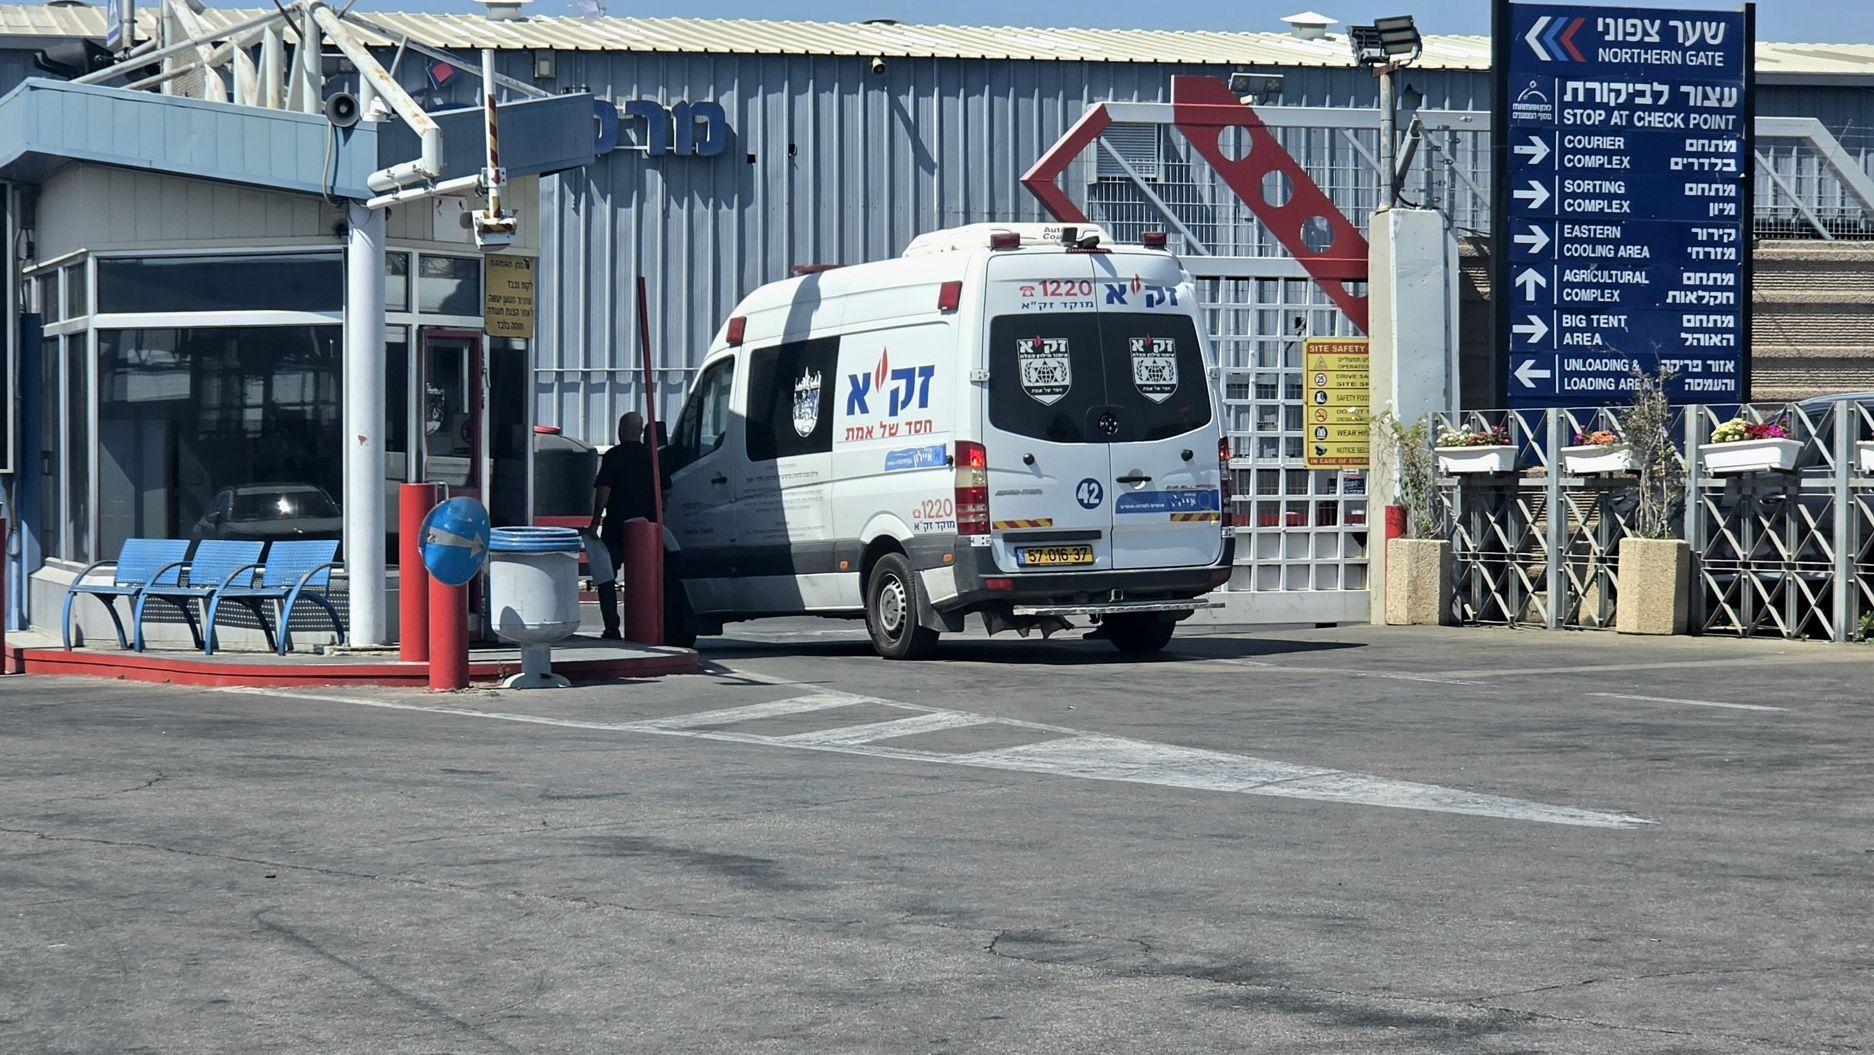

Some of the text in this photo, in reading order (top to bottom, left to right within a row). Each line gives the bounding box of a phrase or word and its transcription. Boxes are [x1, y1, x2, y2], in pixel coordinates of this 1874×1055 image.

[1598, 18, 1725, 46] שער צפוני
[1599, 48, 1724, 66] NORTHERN GATE
[1564, 81, 1737, 107] עצור לביקורת
[1564, 109, 1736, 129] STOP AT CHECK POINT
[1565, 136, 1624, 149] COURIER
[1686, 139, 1737, 152] מתחם
[1565, 155, 1630, 168] COMPLEX
[1671, 158, 1736, 171] בלדרים
[1565, 180, 1625, 193] SORTING
[1685, 183, 1735, 196] מתחם
[1565, 199, 1630, 212] COMPLEX
[1710, 203, 1735, 216] מיון
[1564, 225, 1620, 238] EASTERN
[1691, 228, 1736, 241] קירור
[1564, 244, 1650, 258] COOLING AREA
[1688, 247, 1735, 259] מזרחי
[1563, 270, 1650, 284] AGRICULTURAL
[1683, 273, 1734, 285] מתחם
[1038, 280, 1093, 297] 1220
[1563, 289, 1619, 301] COMPLEX
[1666, 290, 1734, 305] חקלאות
[1060, 301, 1094, 310] מוקד
[1563, 315, 1627, 327] BIG TENT
[1683, 315, 1734, 327] מתחם
[1563, 333, 1602, 345] AREA
[1681, 333, 1734, 346] האוהל
[1309, 344, 1365, 353] SITE SAFETY
[1565, 359, 1629, 371] UNLOADING
[1706, 360, 1735, 372] אזור
[1565, 378, 1651, 390] LOADING AREA
[1685, 379, 1734, 390] והעמסה
[845, 419, 933, 441] חסד של אמת
[1077, 482, 1100, 504] 42
[921, 498, 953, 519] 1220
[935, 520, 956, 532] מוקד
